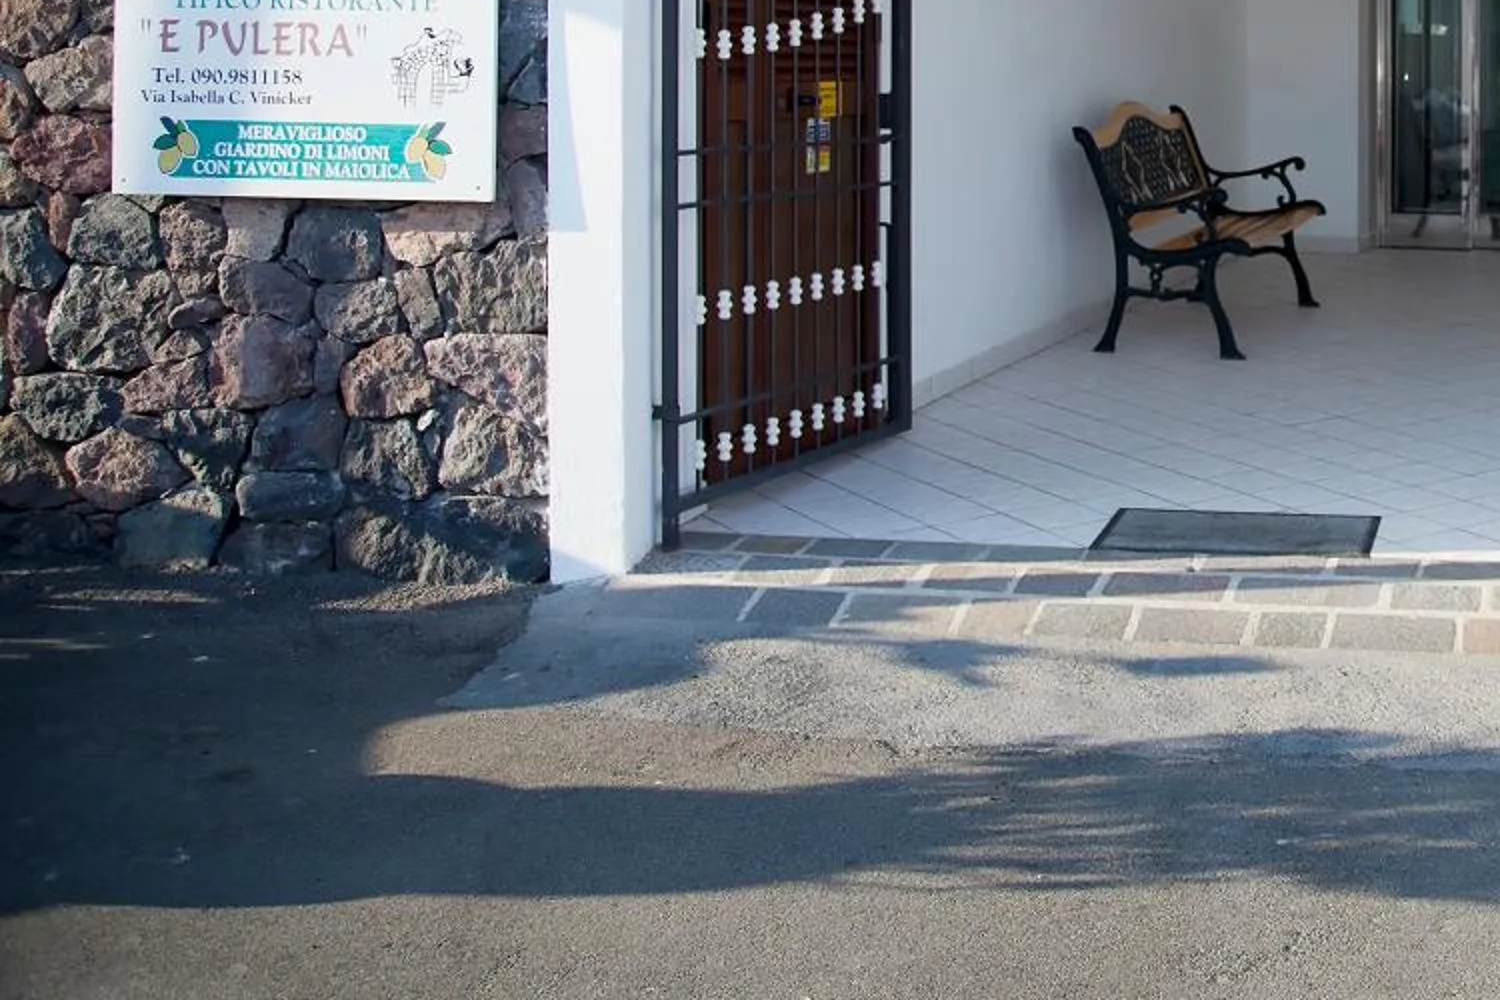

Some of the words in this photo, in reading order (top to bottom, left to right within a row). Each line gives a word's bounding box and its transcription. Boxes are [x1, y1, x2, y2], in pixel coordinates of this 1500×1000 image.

[152, 68, 186, 85] Tel.
[190, 68, 303, 85] 090.9811158
[140, 89, 168, 104] Via
[170, 89, 227, 105] Isabella
[248, 90, 314, 106] Vinicker
[238, 124, 367, 143] MERAVIGLIOSO
[214, 142, 301, 160] GIARDINO
[303, 143, 324, 160] DI
[327, 144, 390, 161] LIMONI
[192, 160, 233, 175] CON
[234, 161, 299, 176] TAVOLI
[301, 162, 321, 177] IN
[323, 162, 411, 180] MAIOLICA
